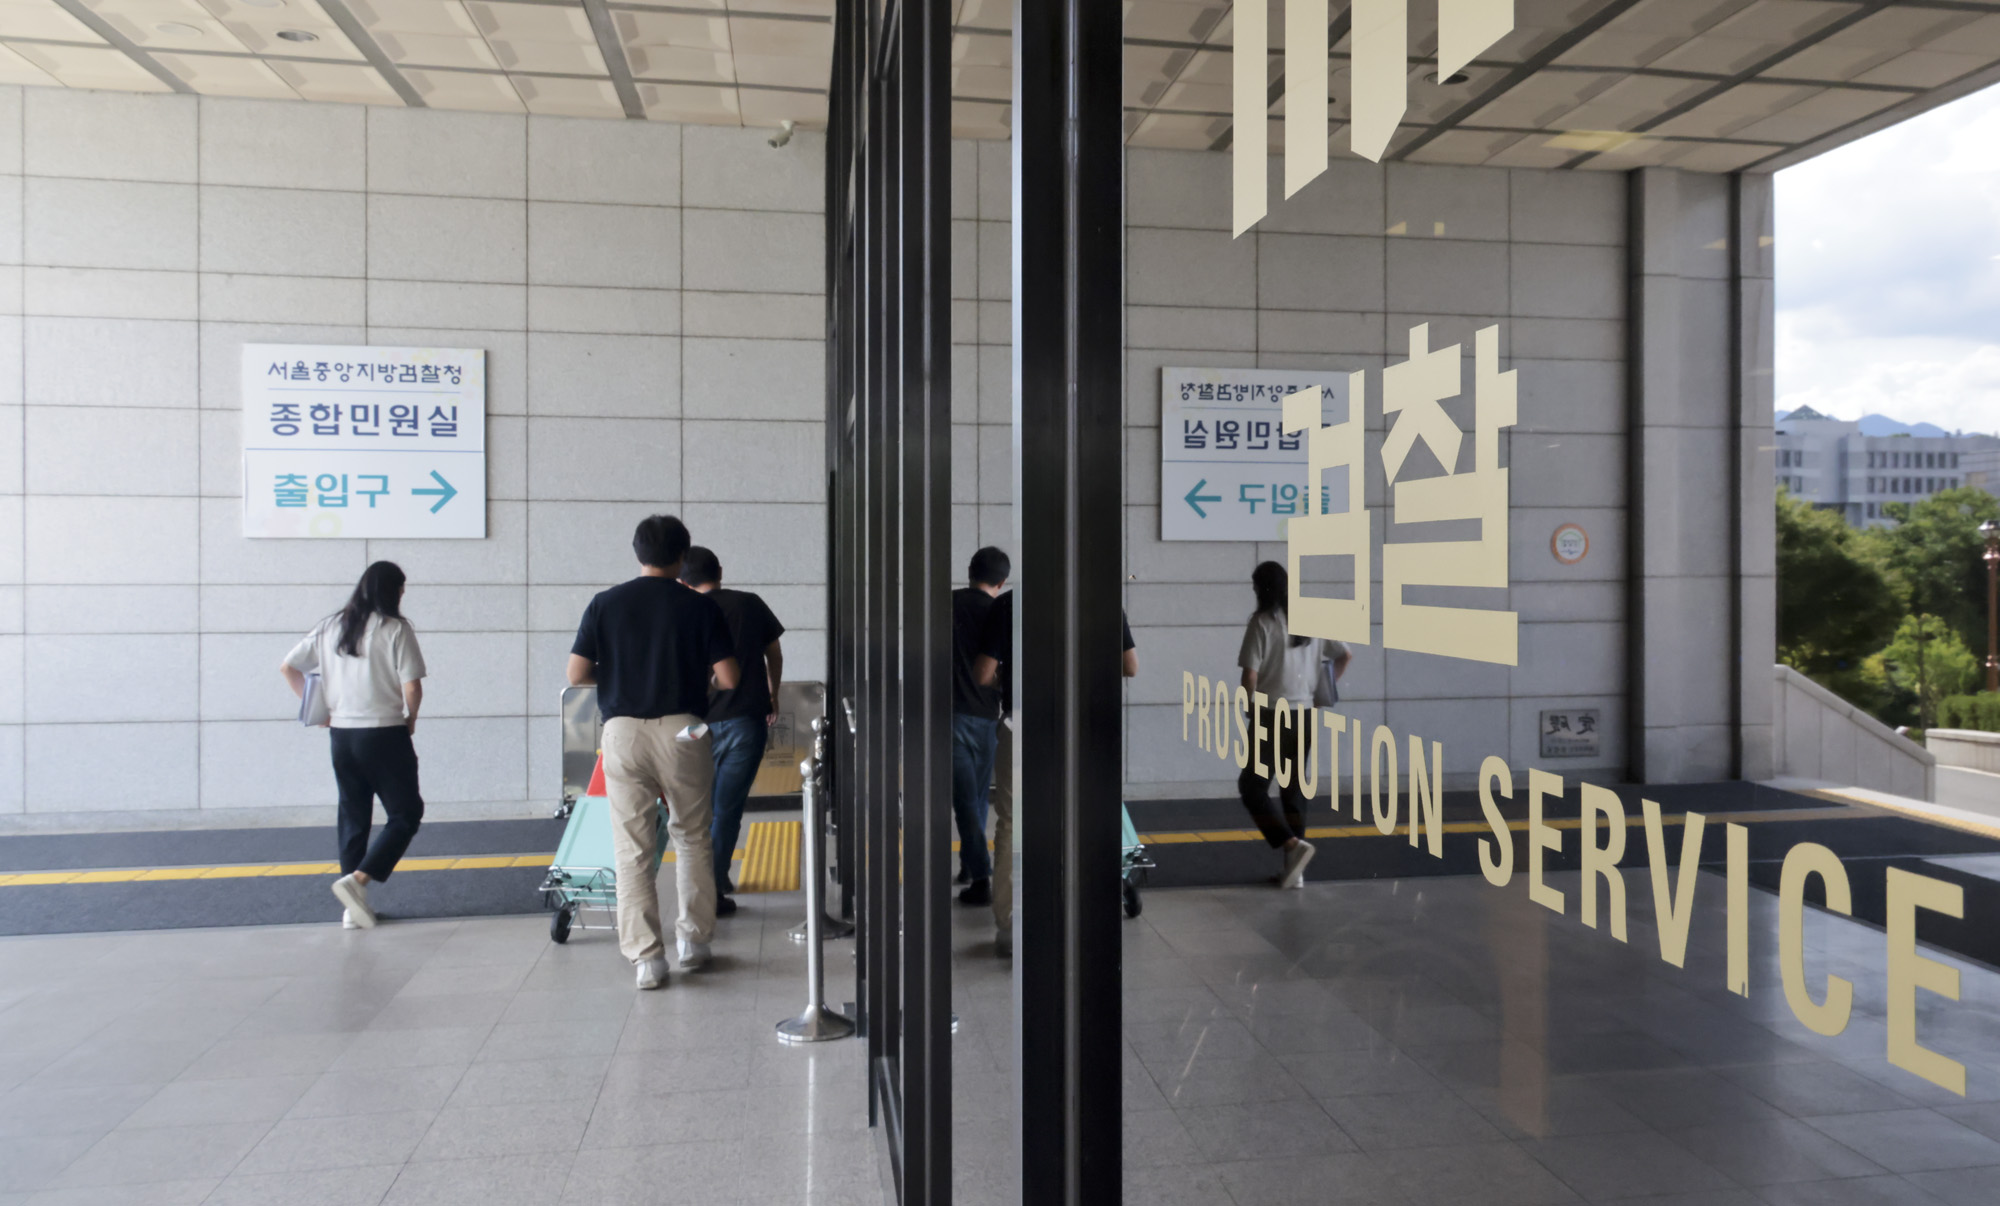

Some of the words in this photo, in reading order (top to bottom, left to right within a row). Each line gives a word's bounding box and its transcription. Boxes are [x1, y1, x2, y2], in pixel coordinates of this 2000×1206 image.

[267, 360, 462, 385] 서울중앙지방검찰청
[270, 403, 458, 437] 종합민원실
[273, 473, 390, 508] 출입구
[1282, 322, 1518, 666] 검찰
[1183, 670, 1443, 859] PROSECUTION
[1478, 756, 1966, 1097] SERVICE
